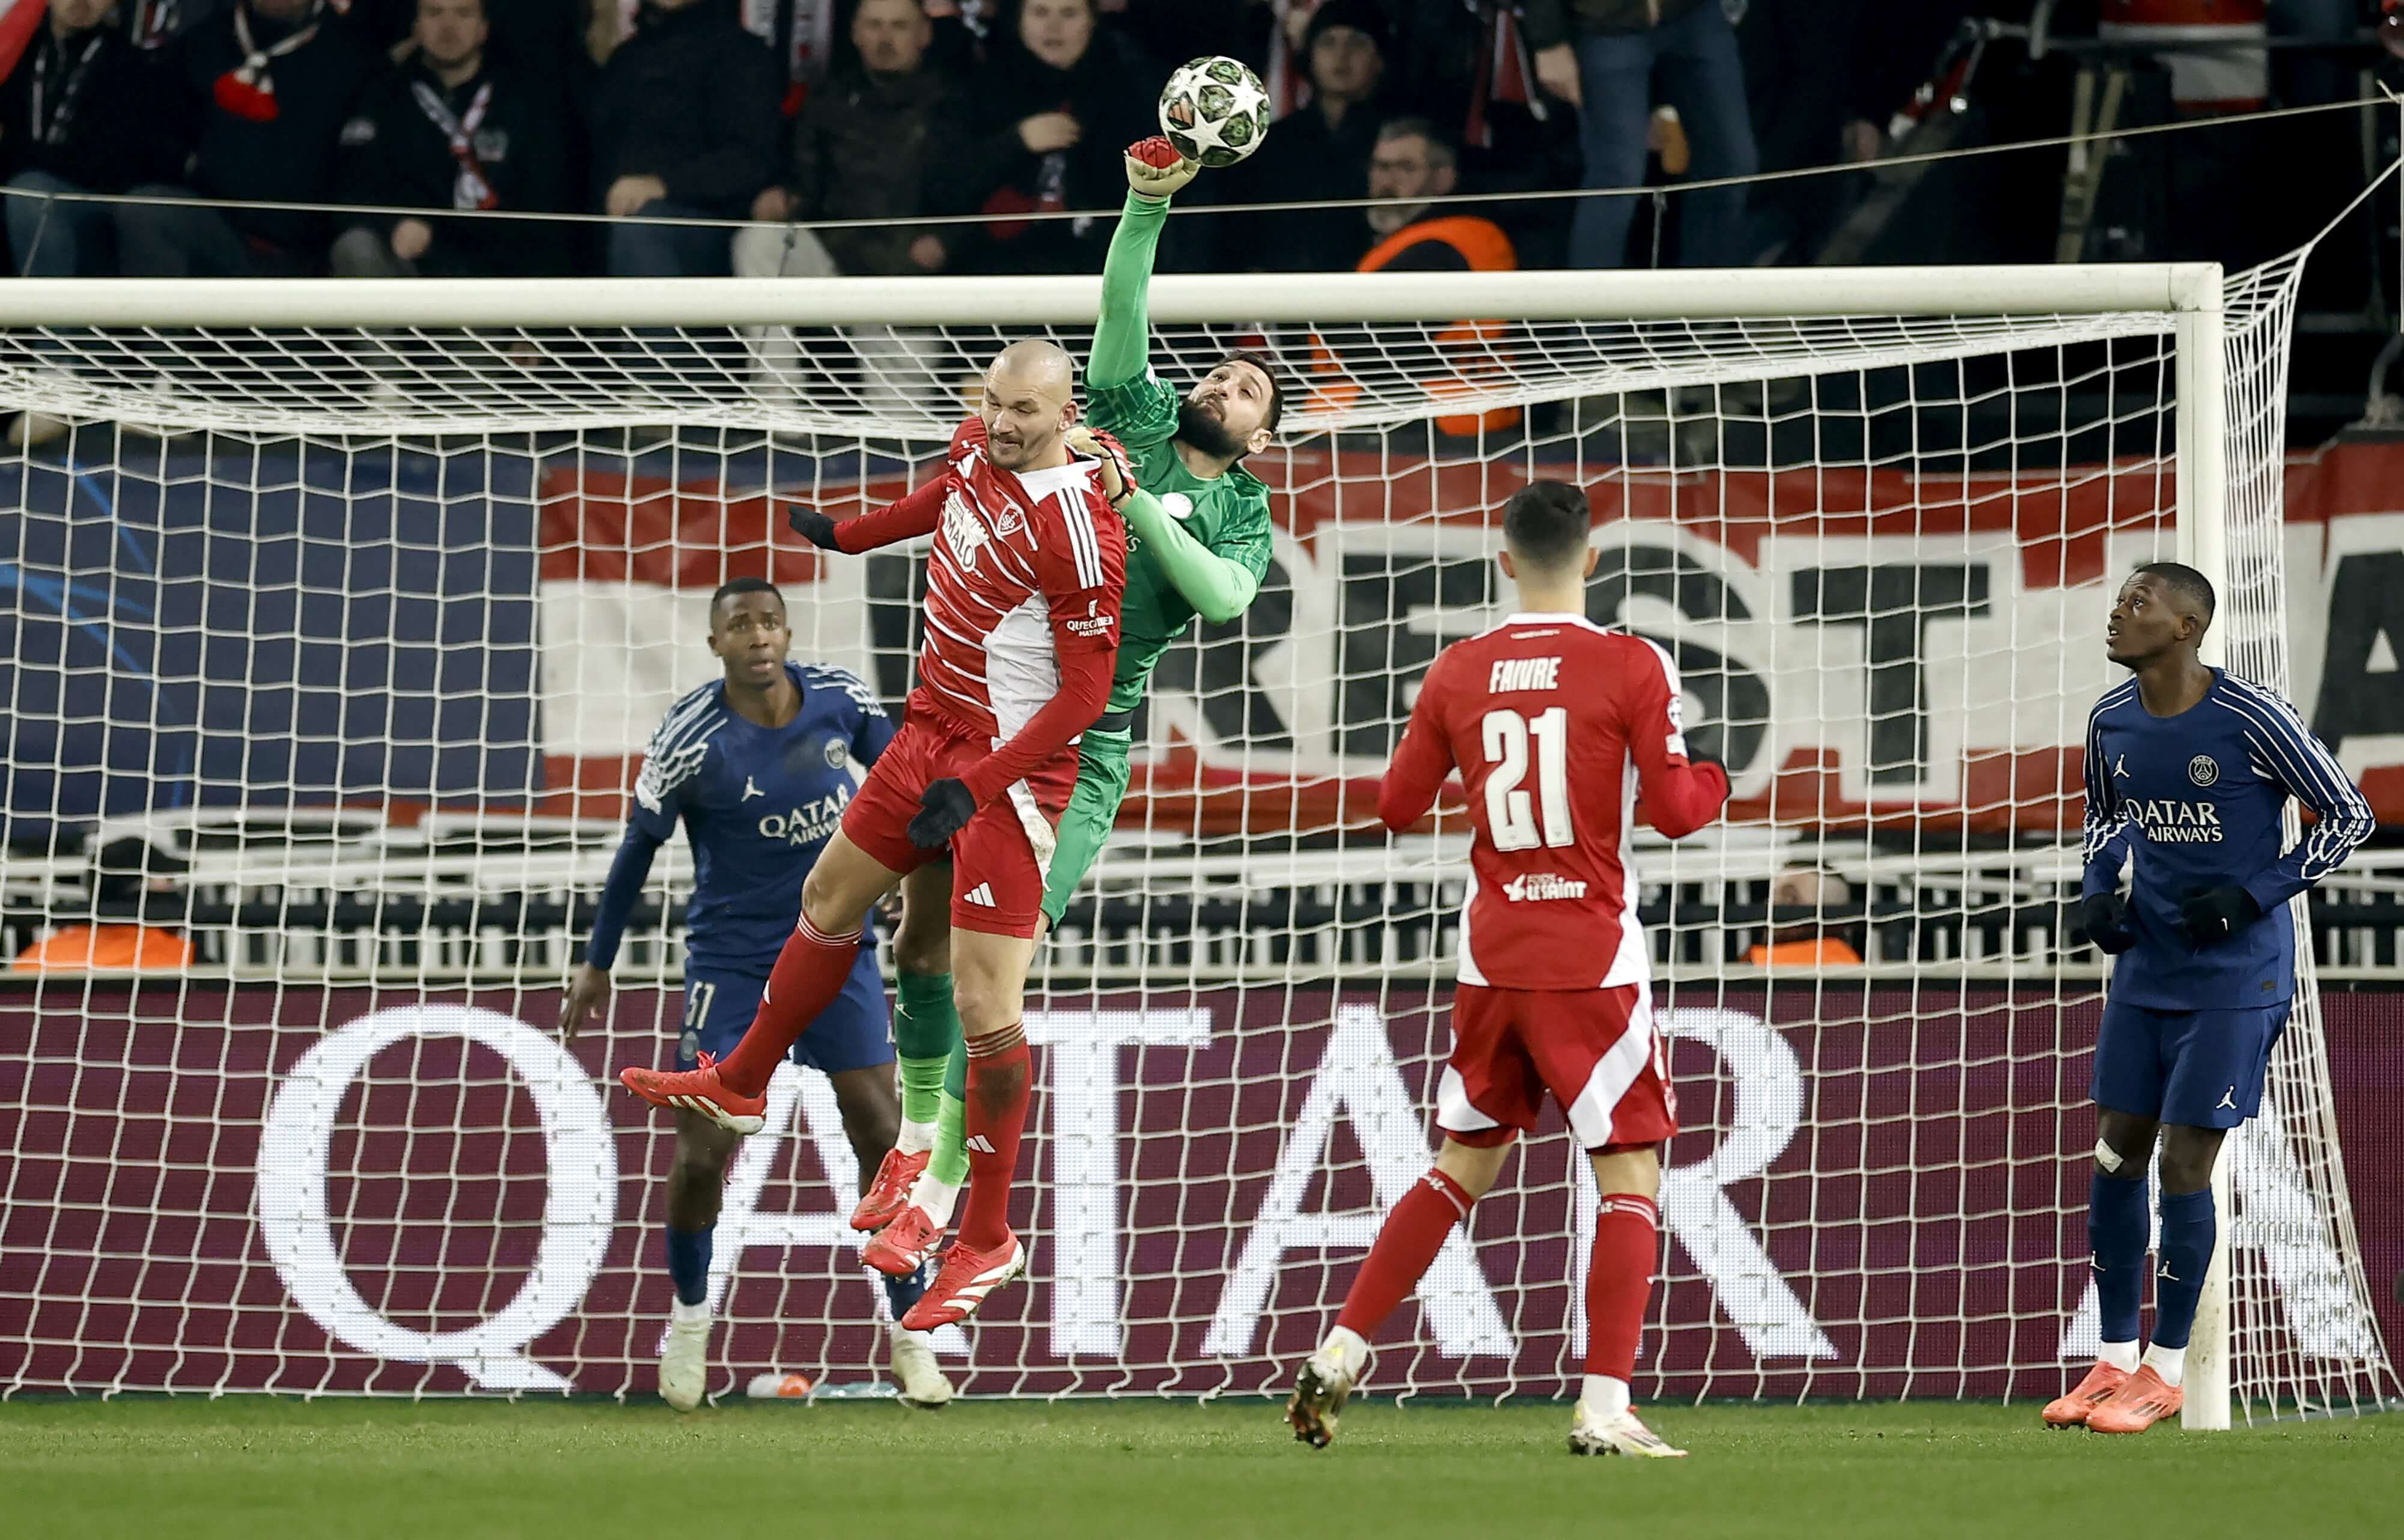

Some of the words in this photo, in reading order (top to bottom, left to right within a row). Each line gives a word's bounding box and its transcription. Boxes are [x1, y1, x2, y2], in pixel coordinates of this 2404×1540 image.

[945, 512, 974, 567] MALO
[1489, 656, 1563, 694] FAIVRE
[1482, 707, 1575, 852] 21
[758, 783, 850, 839] QATAR
[2125, 799, 2221, 829] QATAR
[2147, 826, 2223, 842] AIRWAYS
[685, 980, 716, 1030] 51
[257, 1004, 1839, 1392] QATAR
